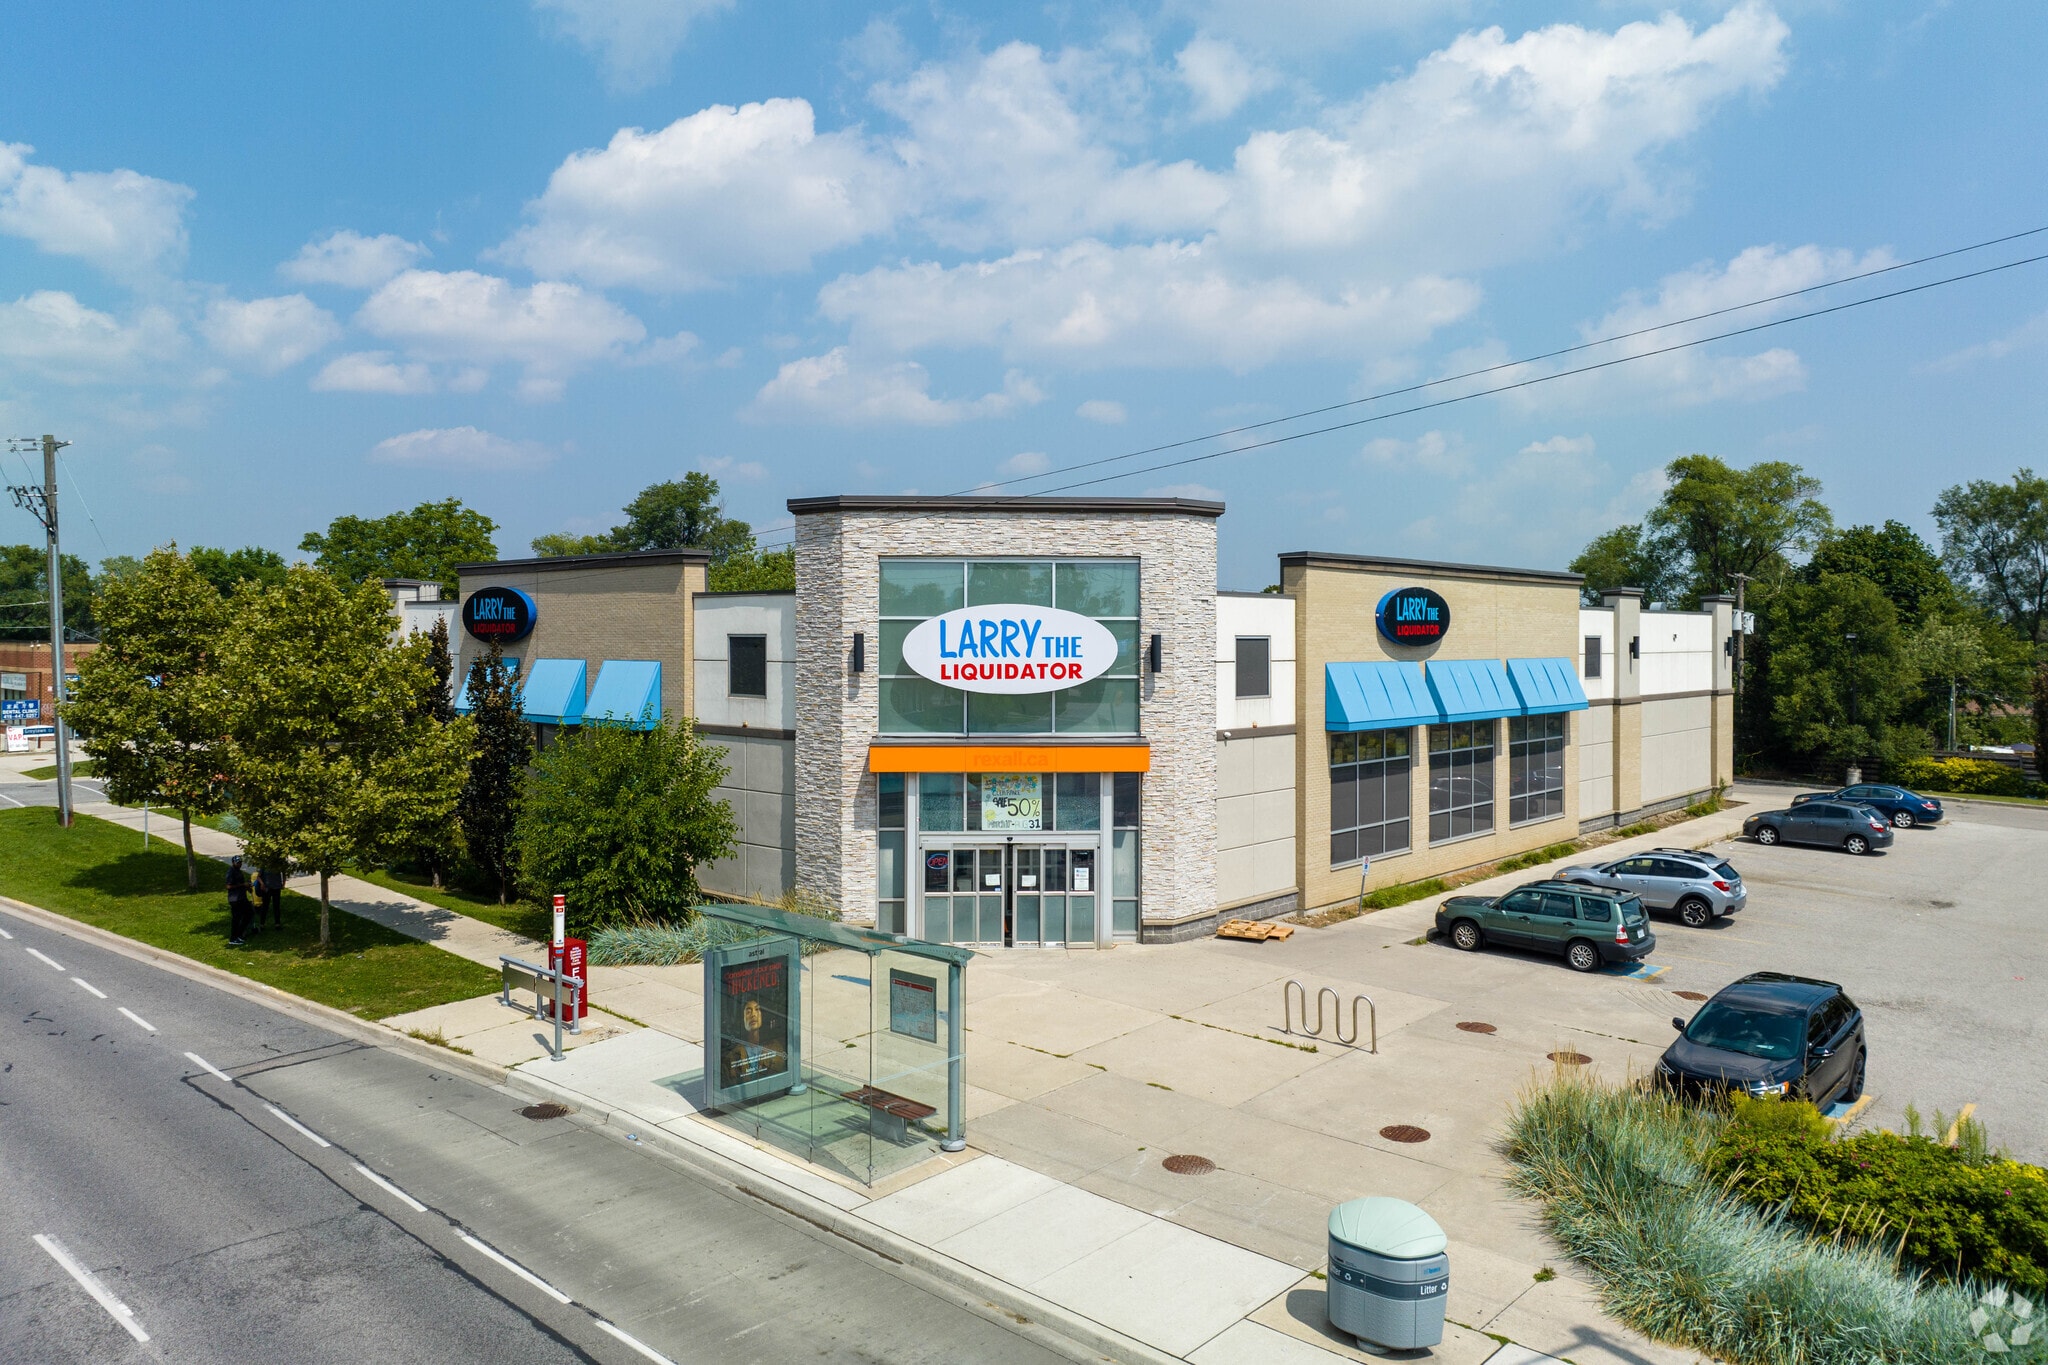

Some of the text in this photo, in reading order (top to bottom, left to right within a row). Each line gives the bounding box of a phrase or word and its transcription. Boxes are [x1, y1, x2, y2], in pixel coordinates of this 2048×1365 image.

[473, 597, 516, 620] LARRY THE
[1396, 597, 1439, 621] LARRY THE
[473, 623, 516, 634] LIQUIDATOR
[1397, 624, 1440, 636] LIQUIDATOR
[939, 618, 1083, 658] LARRY THE
[940, 662, 1083, 681] LIQUIDATOR
[973, 750, 1049, 767] rexall.ca
[1007, 798, 1041, 817] 50%
[1028, 819, 1041, 829] 31
[928, 857, 949, 867] OPEN
[748, 948, 765, 958] astral
[1420, 1284, 1438, 1296] Litter
